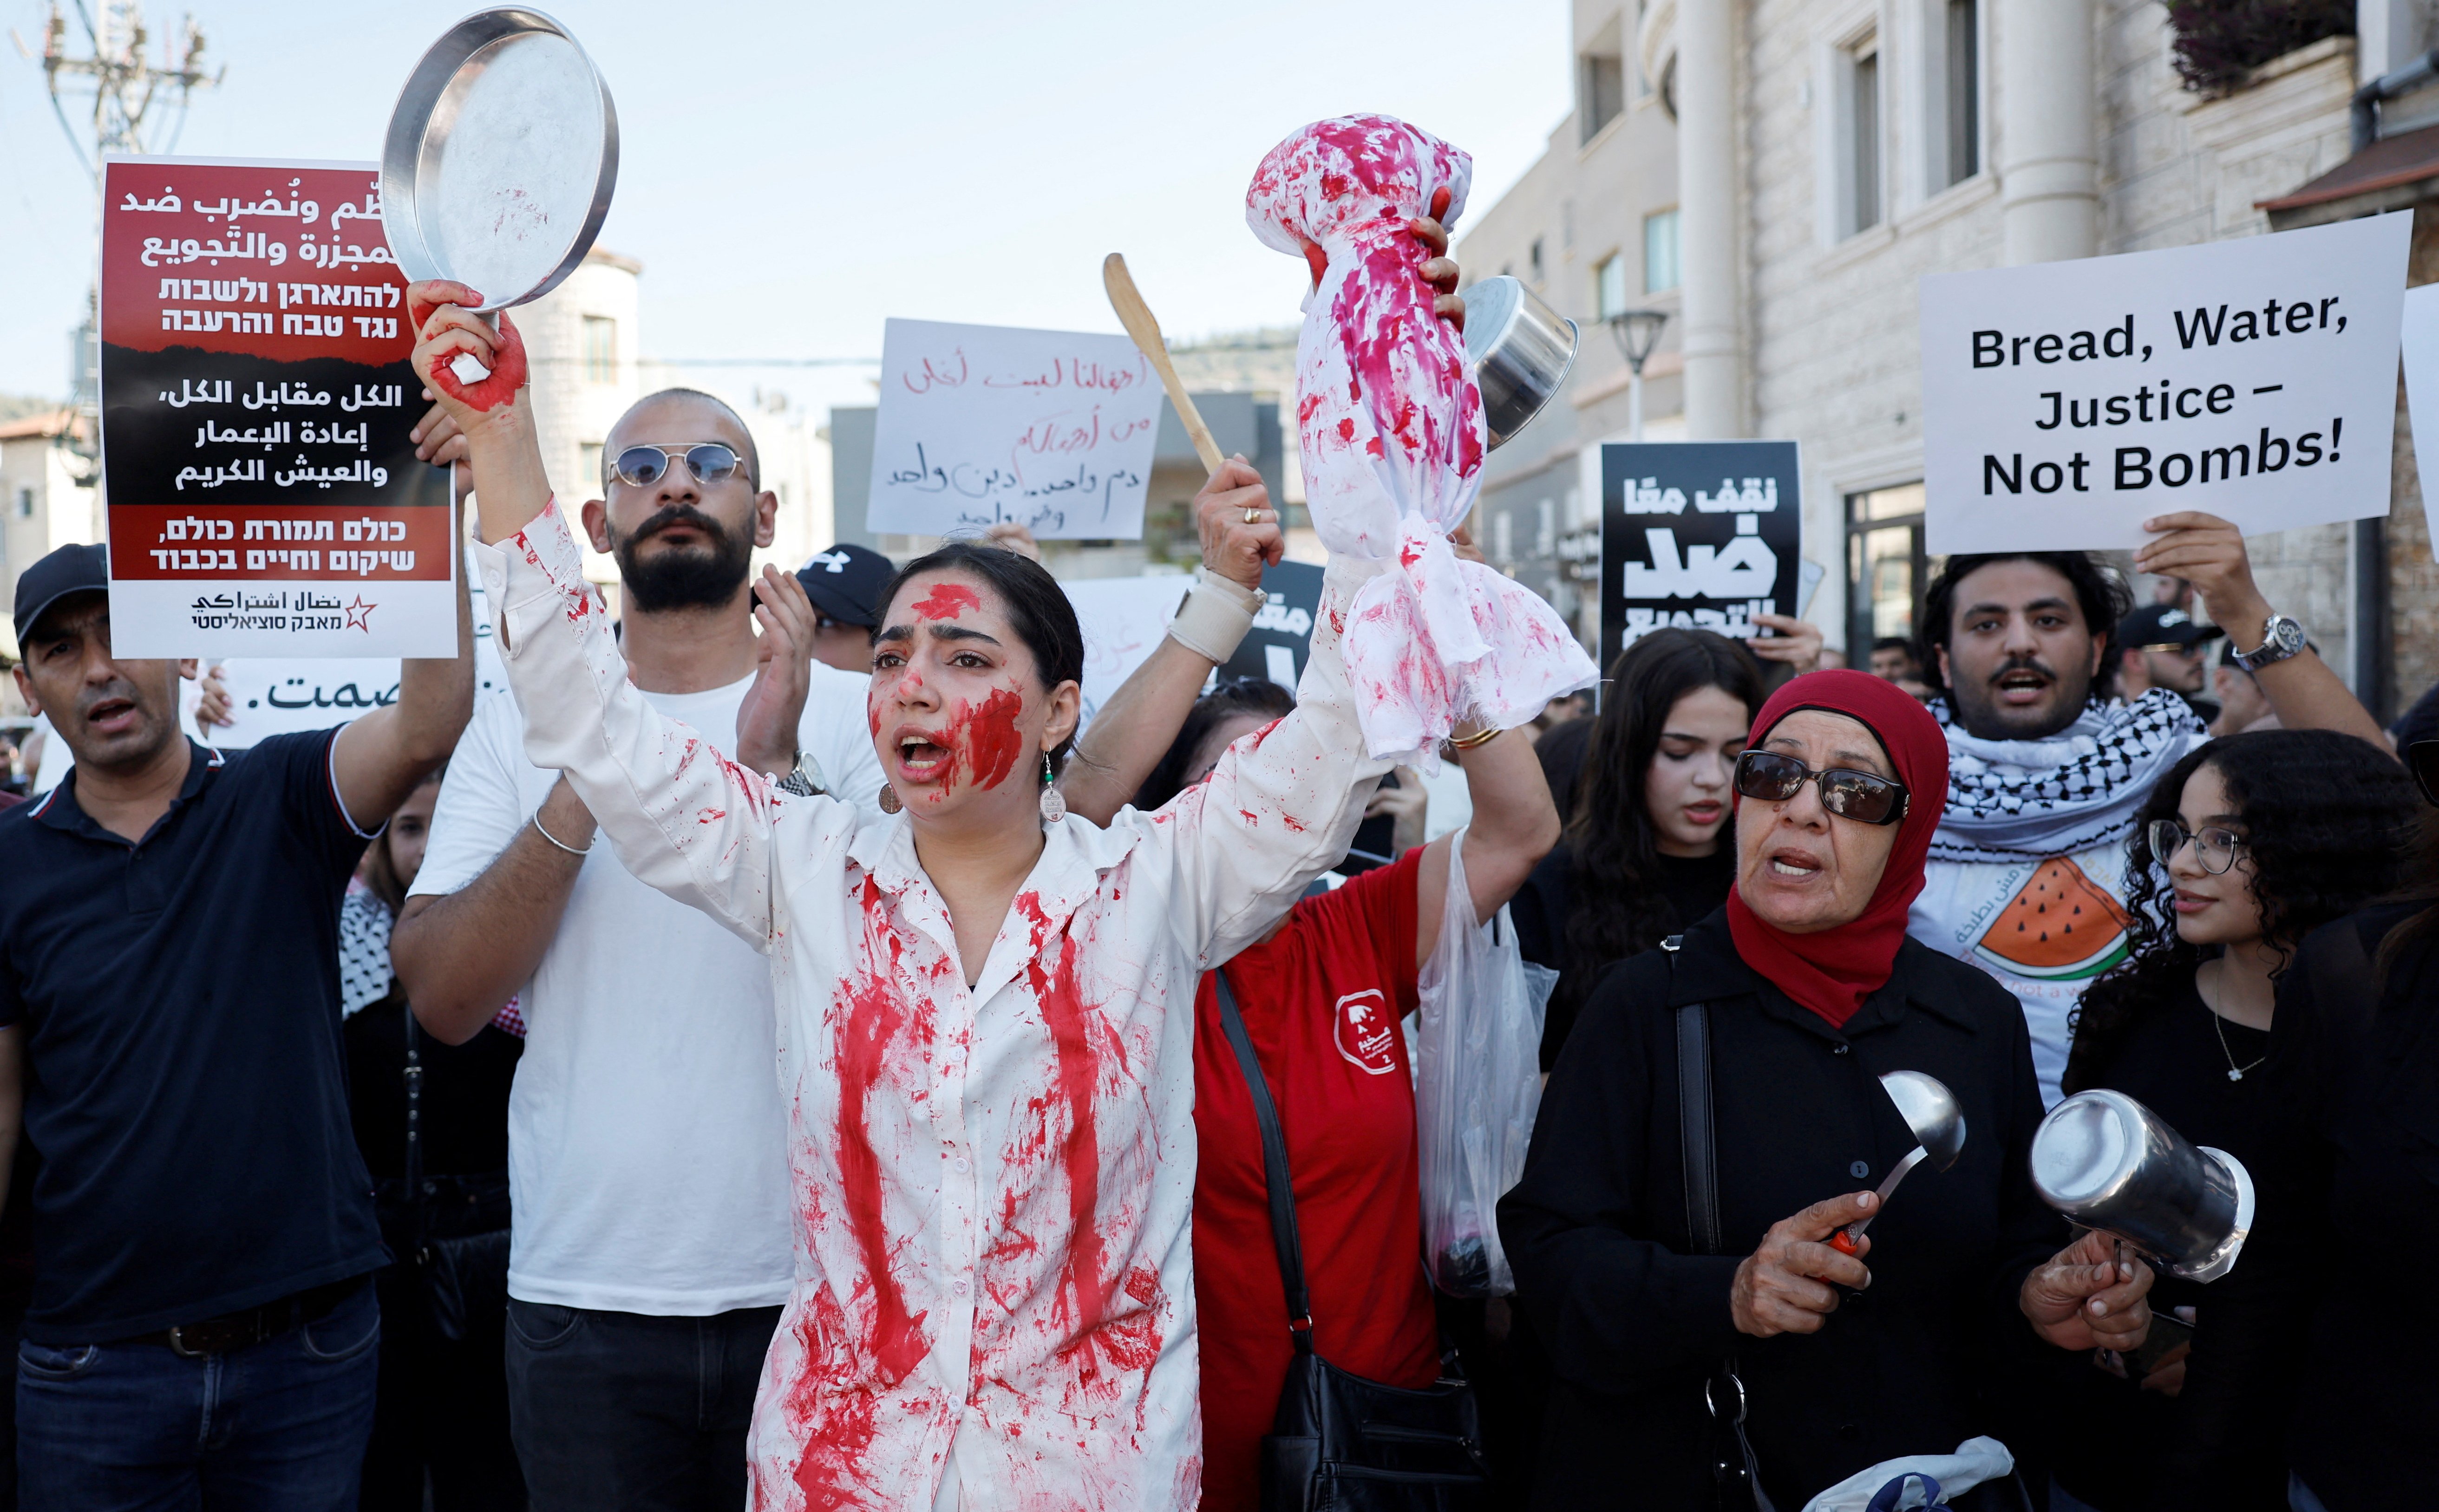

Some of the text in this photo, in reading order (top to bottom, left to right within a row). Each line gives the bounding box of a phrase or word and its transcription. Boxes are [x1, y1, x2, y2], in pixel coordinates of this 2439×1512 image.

[120, 185, 182, 213] ضد
[299, 234, 399, 272] مجزرة
[158, 277, 401, 310] להתארגן ולשבות
[162, 309, 398, 339] נגד טבח והרעבה
[1971, 295, 2349, 369] Bread, Water,
[242, 381, 331, 412] مقابل
[340, 384, 402, 412] الكل
[2035, 379, 2235, 430] Justice
[195, 419, 368, 452] إعادة الإعمار
[1110, 418, 1151, 443] من
[175, 453, 388, 491] والعيش الكريم
[886, 442, 948, 493] واحد
[1982, 417, 2343, 496] Not Bombs!
[1694, 477, 1779, 514] نقف
[158, 515, 406, 543] כולם תמורת כולם,
[150, 549, 415, 576] שיקום וחיים בכבוד
[1623, 513, 1778, 599] ضد
[190, 591, 341, 613] نضال اشتراكي
[191, 613, 341, 632] מאבק סוציאליסטי
